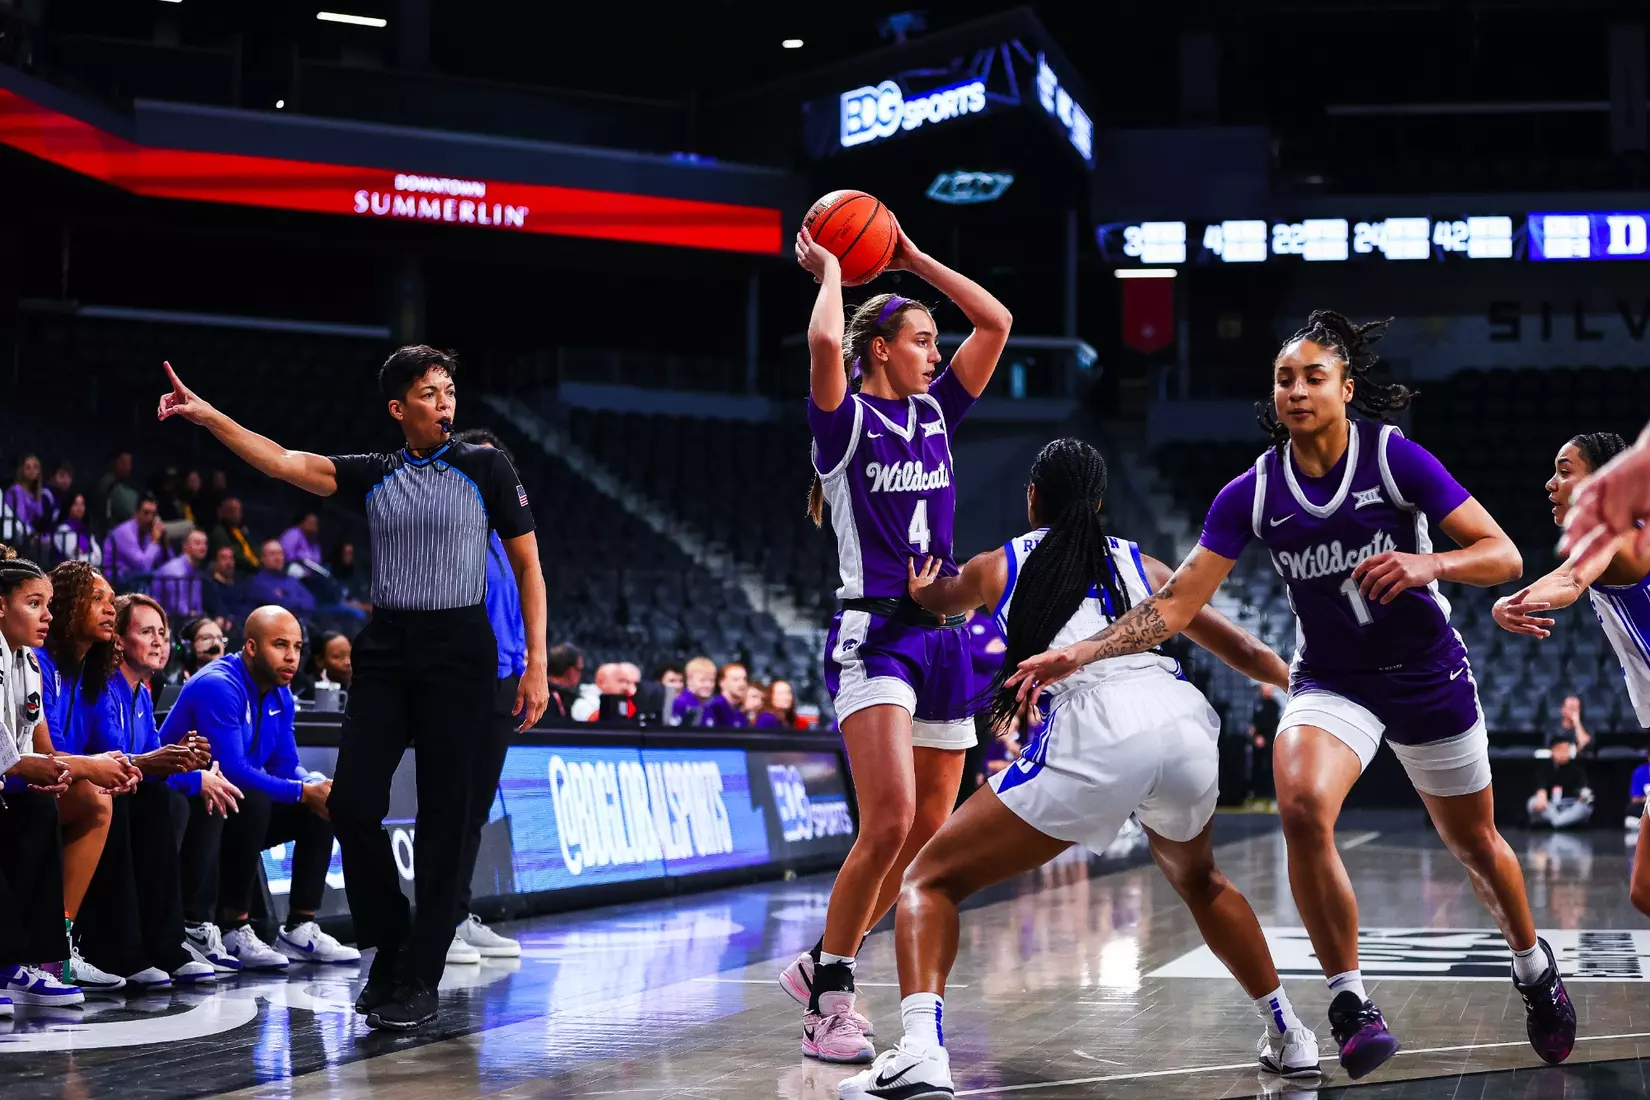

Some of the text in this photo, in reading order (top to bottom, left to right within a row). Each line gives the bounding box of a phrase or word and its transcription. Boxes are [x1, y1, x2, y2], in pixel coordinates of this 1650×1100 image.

[902, 82, 985, 130] SPORTS
[354, 190, 525, 227] SUMMERLIN
[395, 173, 486, 198] DOWNTOWN
[866, 460, 950, 493] Wildcats
[908, 499, 931, 553] 4
[1279, 529, 1397, 580] Wildcats
[1340, 577, 1374, 627] 1
